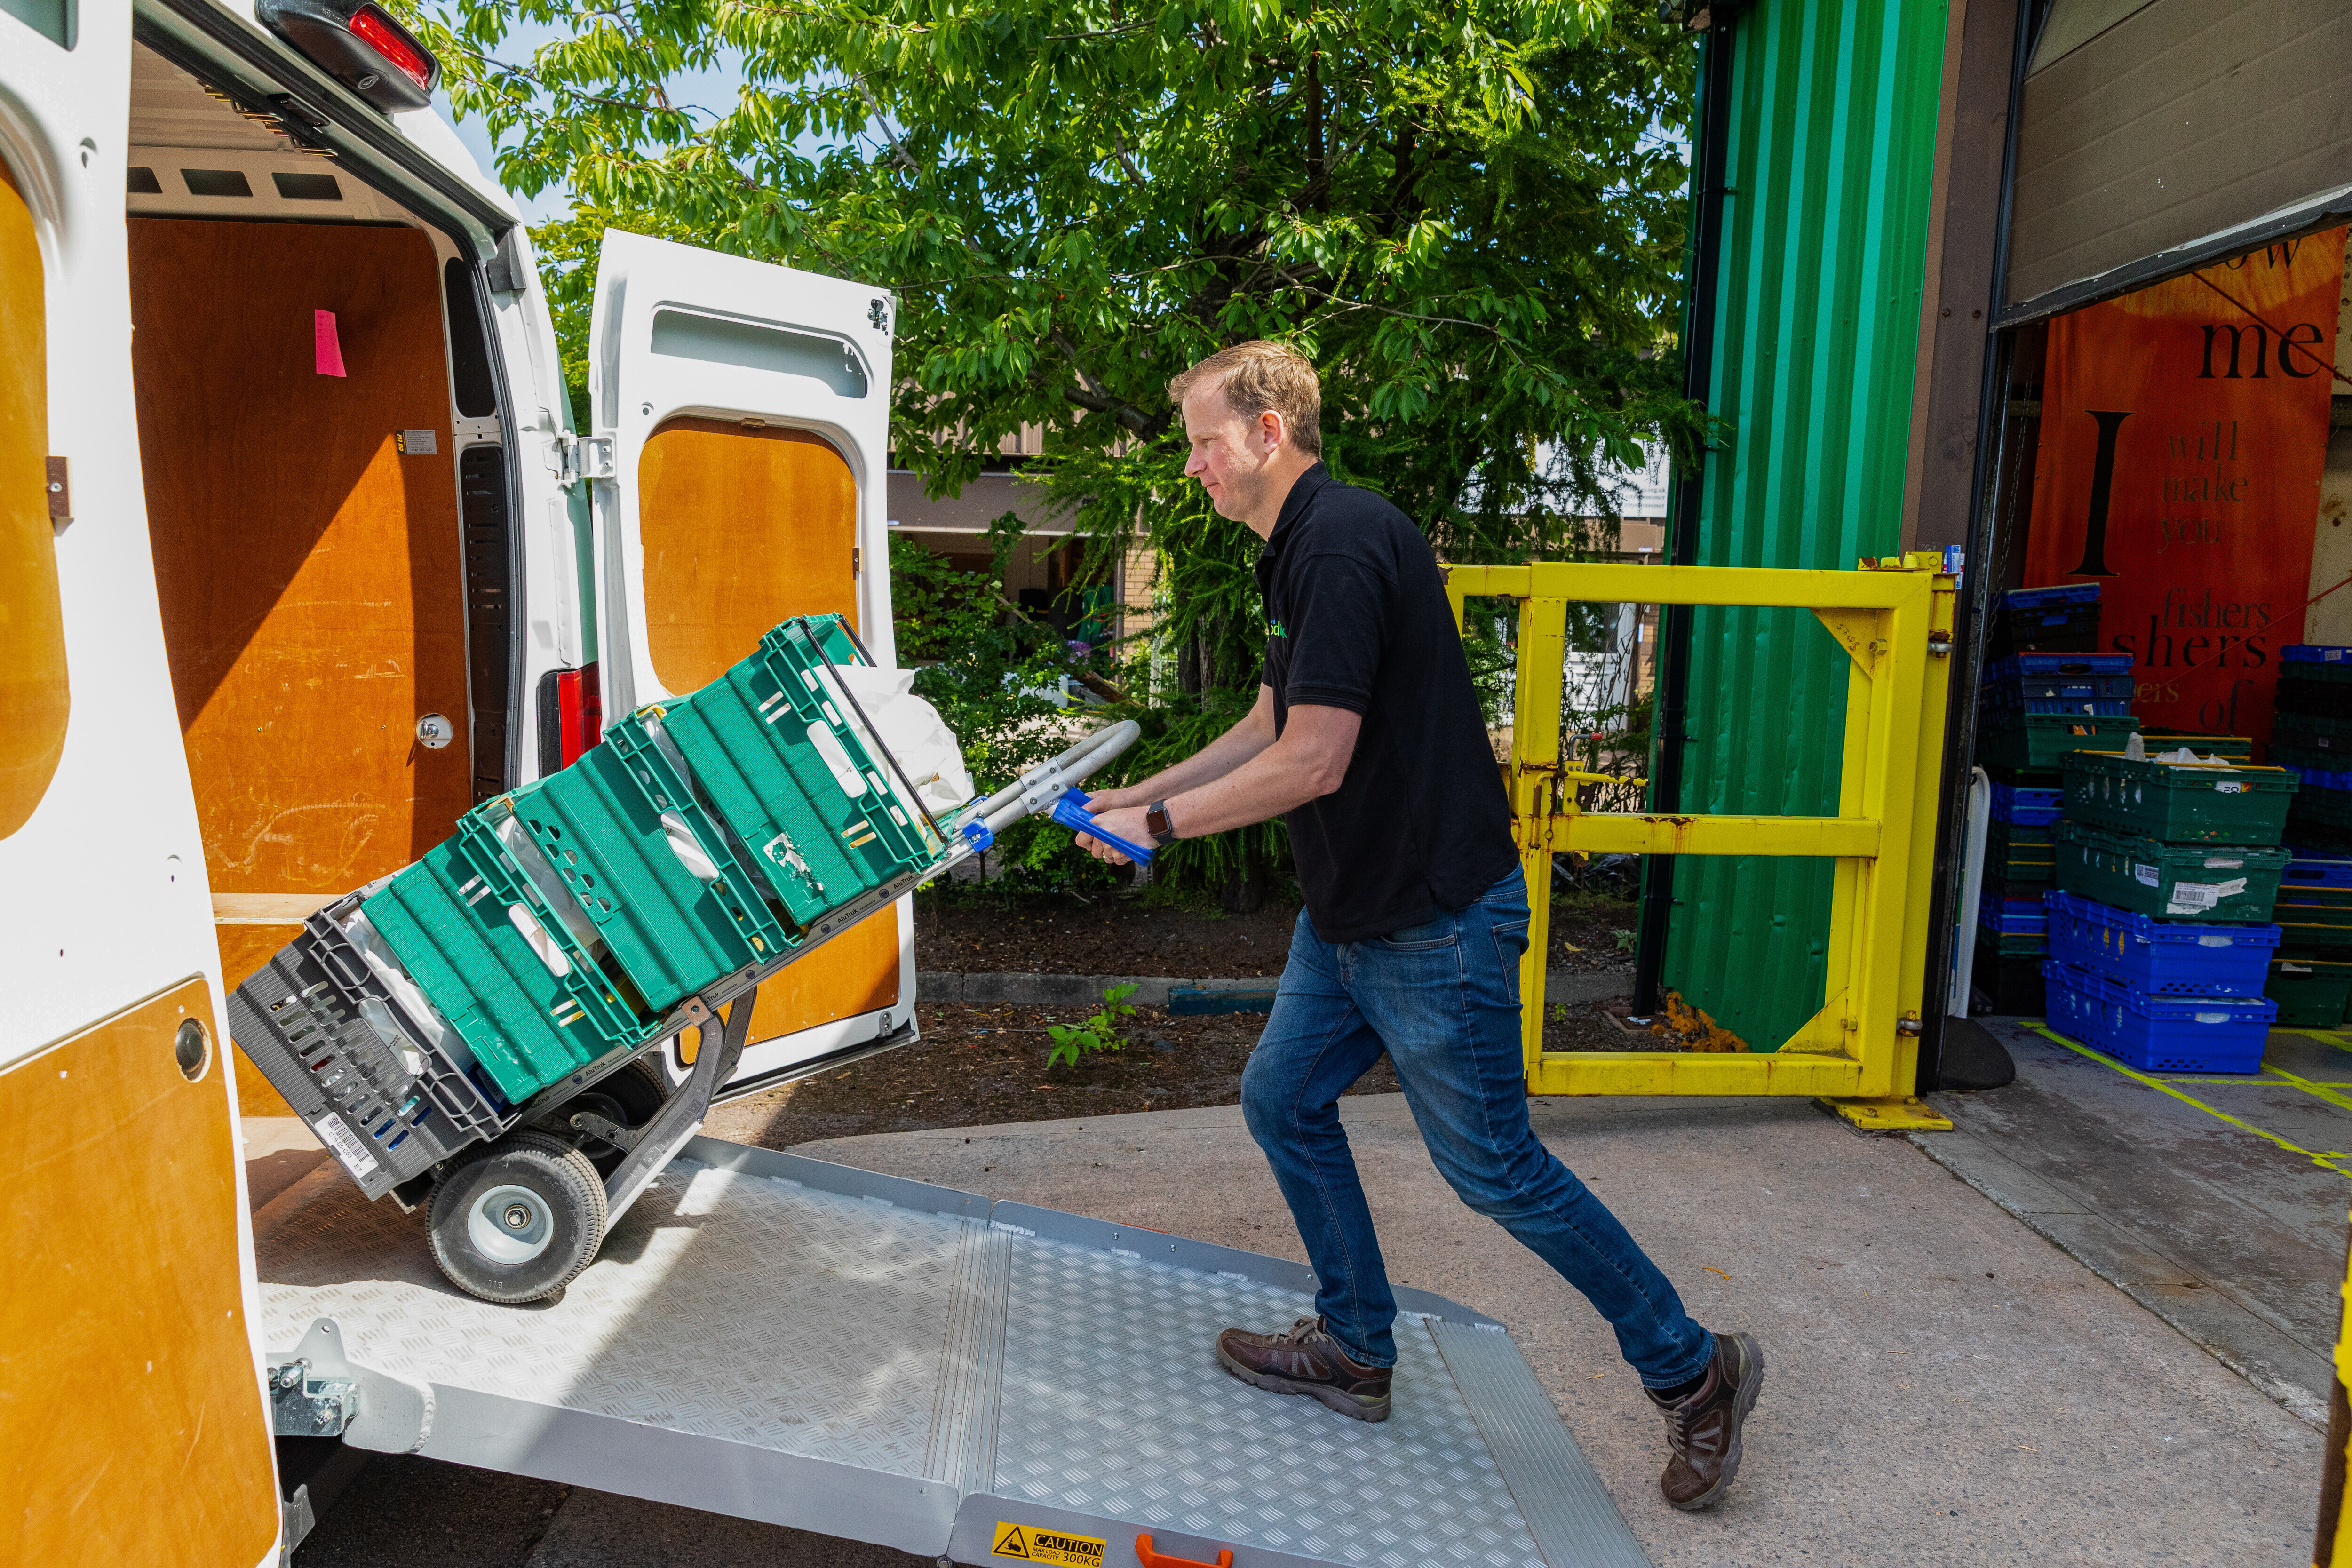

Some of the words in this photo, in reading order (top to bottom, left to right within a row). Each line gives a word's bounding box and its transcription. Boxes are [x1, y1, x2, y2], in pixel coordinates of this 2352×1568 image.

[2196, 323, 2324, 378] me
[2169, 421, 2238, 461] will
[2064, 409, 2137, 577] I
[2162, 462, 2248, 502] make
[2158, 518, 2220, 554] you
[2160, 588, 2270, 628] fishers
[2198, 679, 2254, 730] of
[712, 724, 758, 789] LABEL
[894, 875, 914, 890] AluTruk
[838, 908, 858, 923] AluTruk
[415, 908, 462, 973] LABEL
[586, 1062, 606, 1077] AluTruk
[530, 1095, 551, 1110] AluTruk
[328, 1132, 352, 1159] C19-05-C03
[354, 1163, 362, 1171] E7
[1036, 1535, 1103, 1556] CAUTION
[1062, 1552, 1101, 1567] 300KG
